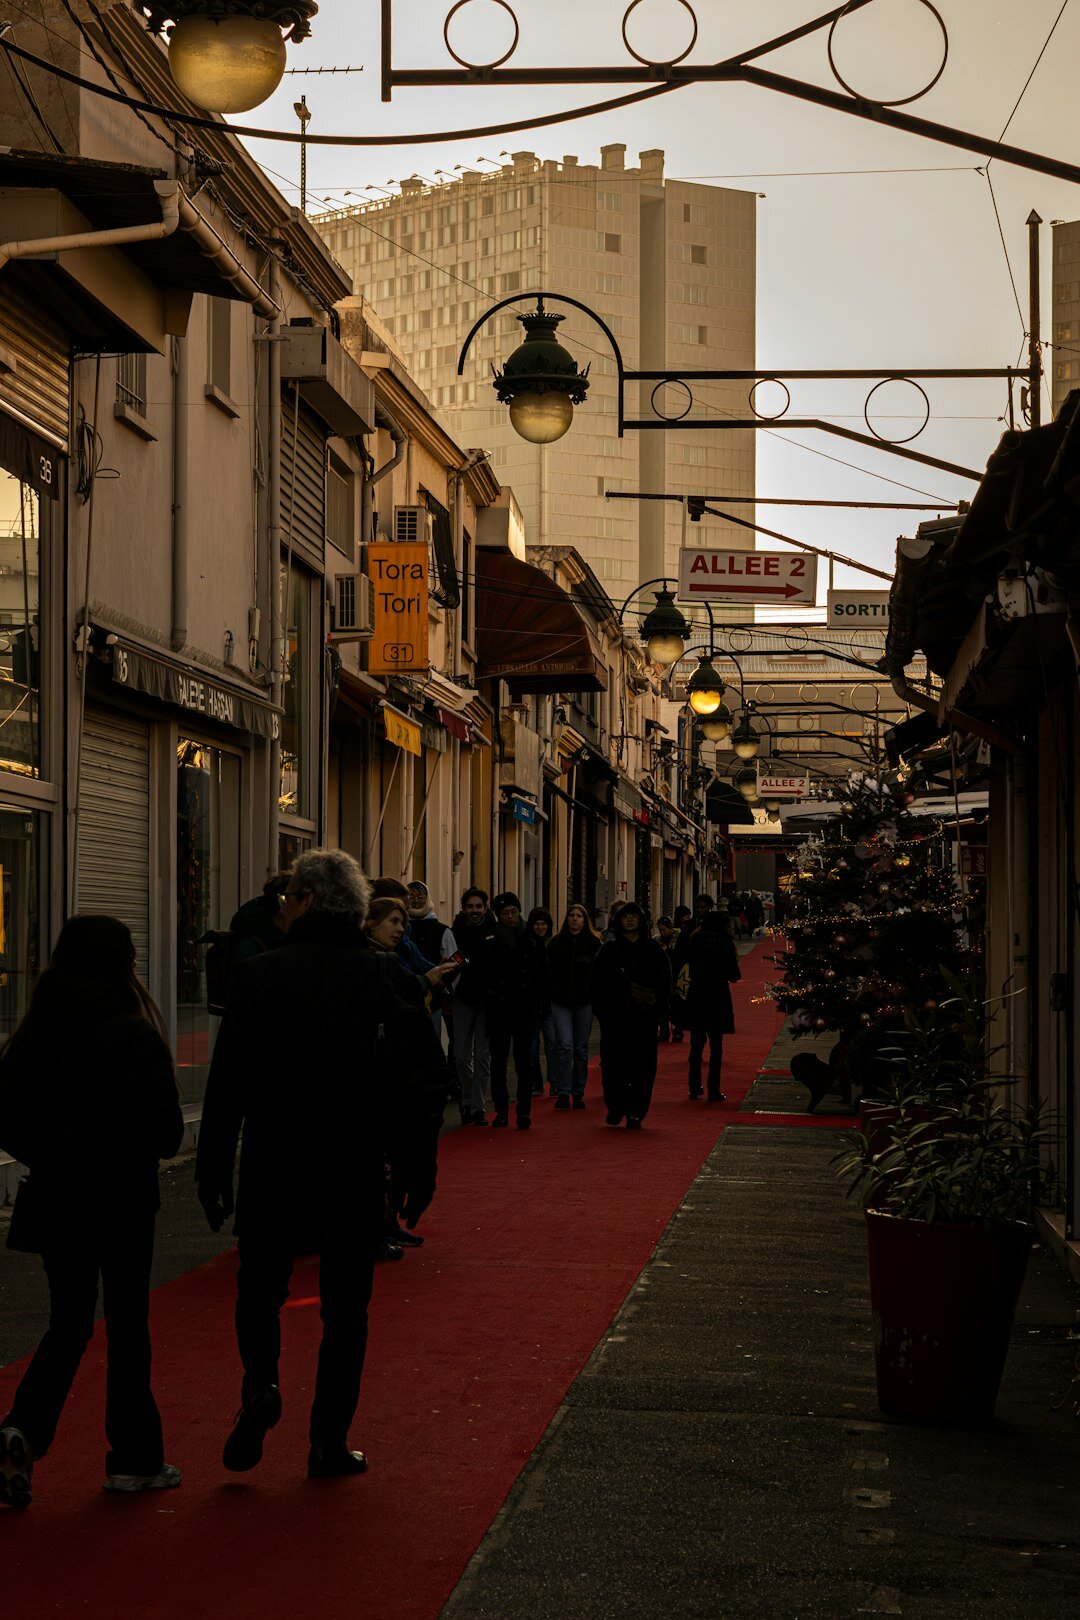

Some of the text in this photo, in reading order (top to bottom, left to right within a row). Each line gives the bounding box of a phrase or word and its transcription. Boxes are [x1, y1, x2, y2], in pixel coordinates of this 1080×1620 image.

[40, 455, 52, 485] 36
[373, 559, 424, 580] Tora
[690, 554, 806, 577] ALLEE 2
[378, 592, 420, 613] Tori
[834, 603, 889, 616] SORTI
[390, 646, 407, 660] 31
[761, 779, 805, 787] ALLEE 2
